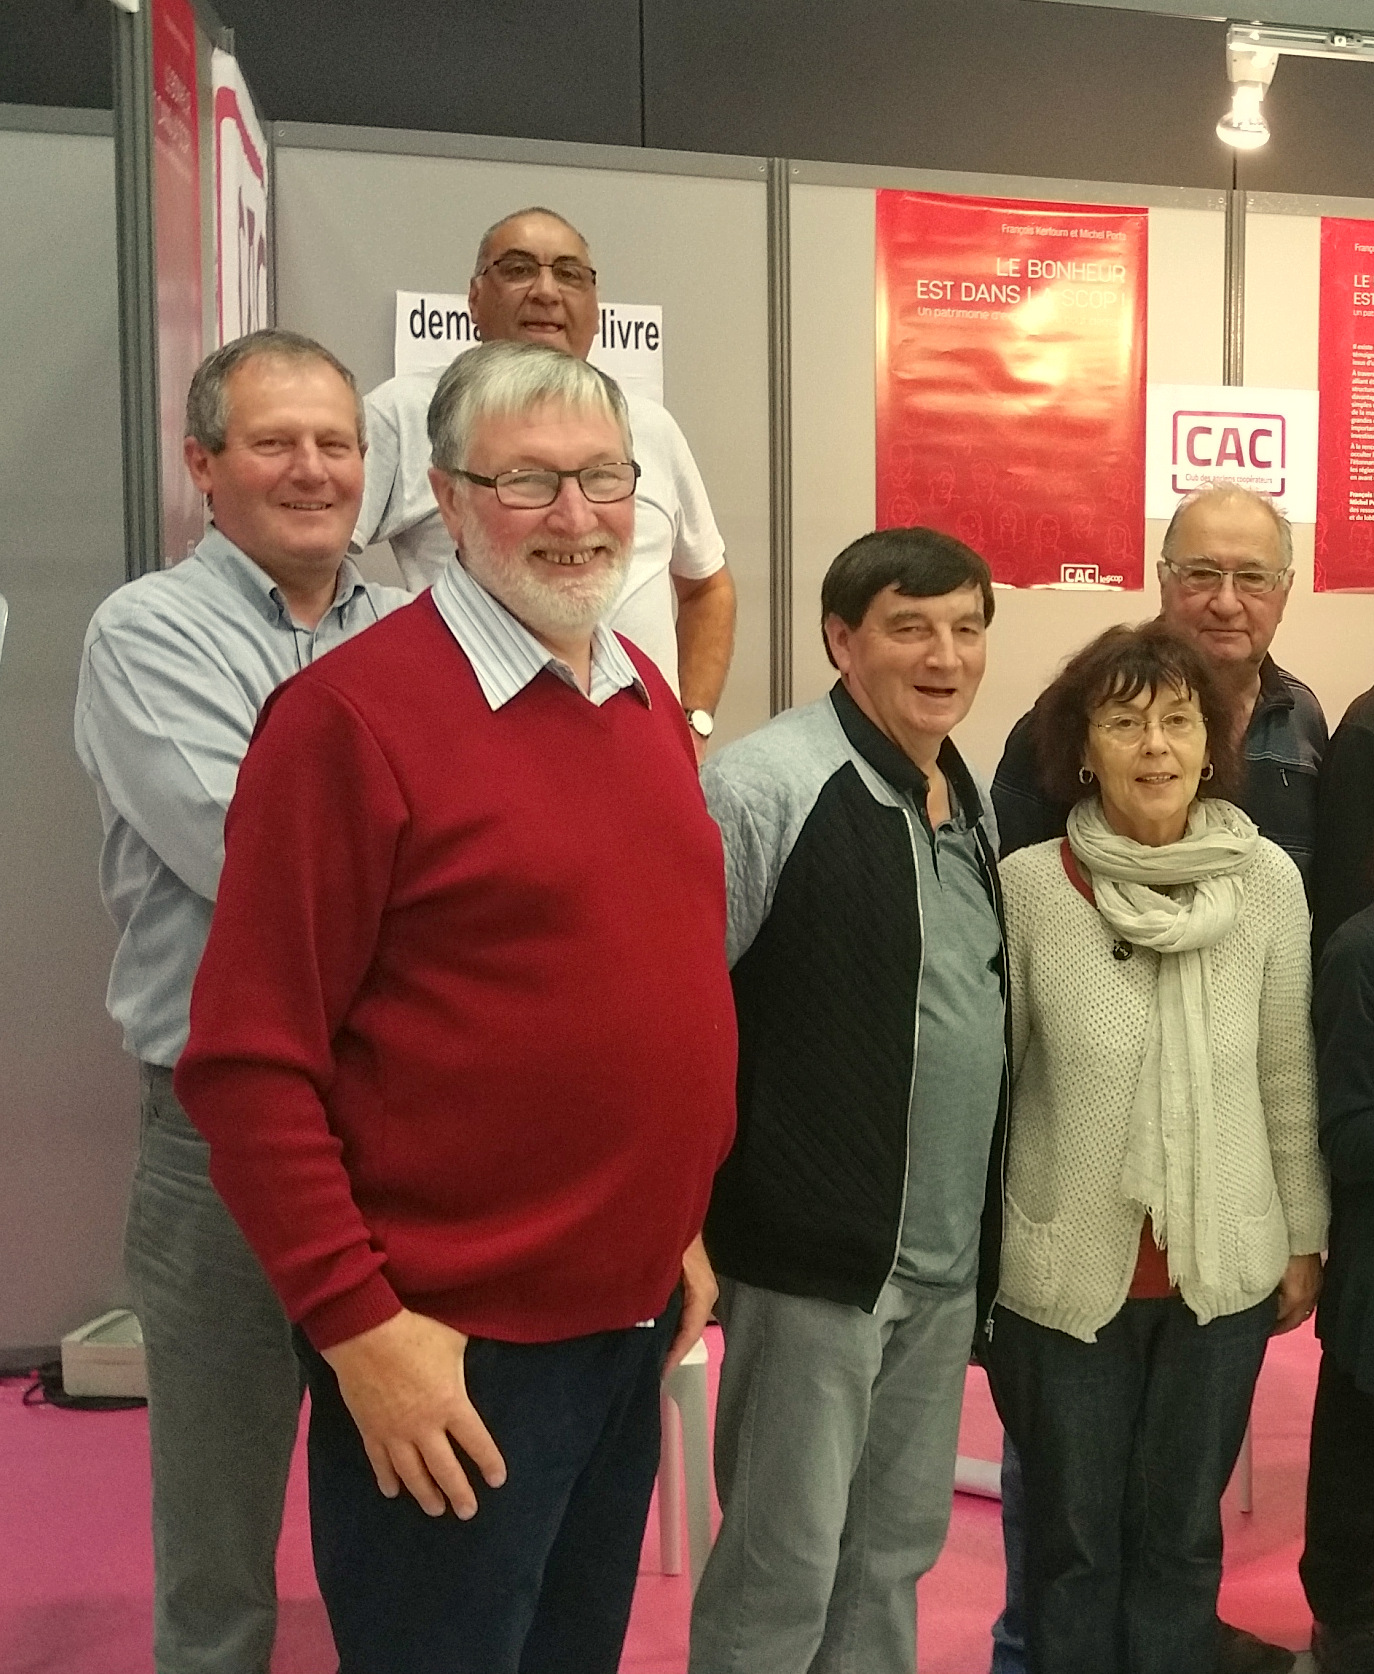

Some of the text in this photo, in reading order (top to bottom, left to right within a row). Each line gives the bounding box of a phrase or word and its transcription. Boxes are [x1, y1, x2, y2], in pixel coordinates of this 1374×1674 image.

[1069, 227, 1079, 238] et
[995, 256, 1126, 284] LE BONHEUR
[1353, 274, 1371, 288] LE
[916, 279, 955, 301] EST
[960, 281, 1021, 304] DANS
[933, 307, 990, 321] patrimoine
[601, 308, 659, 352] livre
[1185, 425, 1273, 469] CAC
[1065, 568, 1095, 583] CAC
